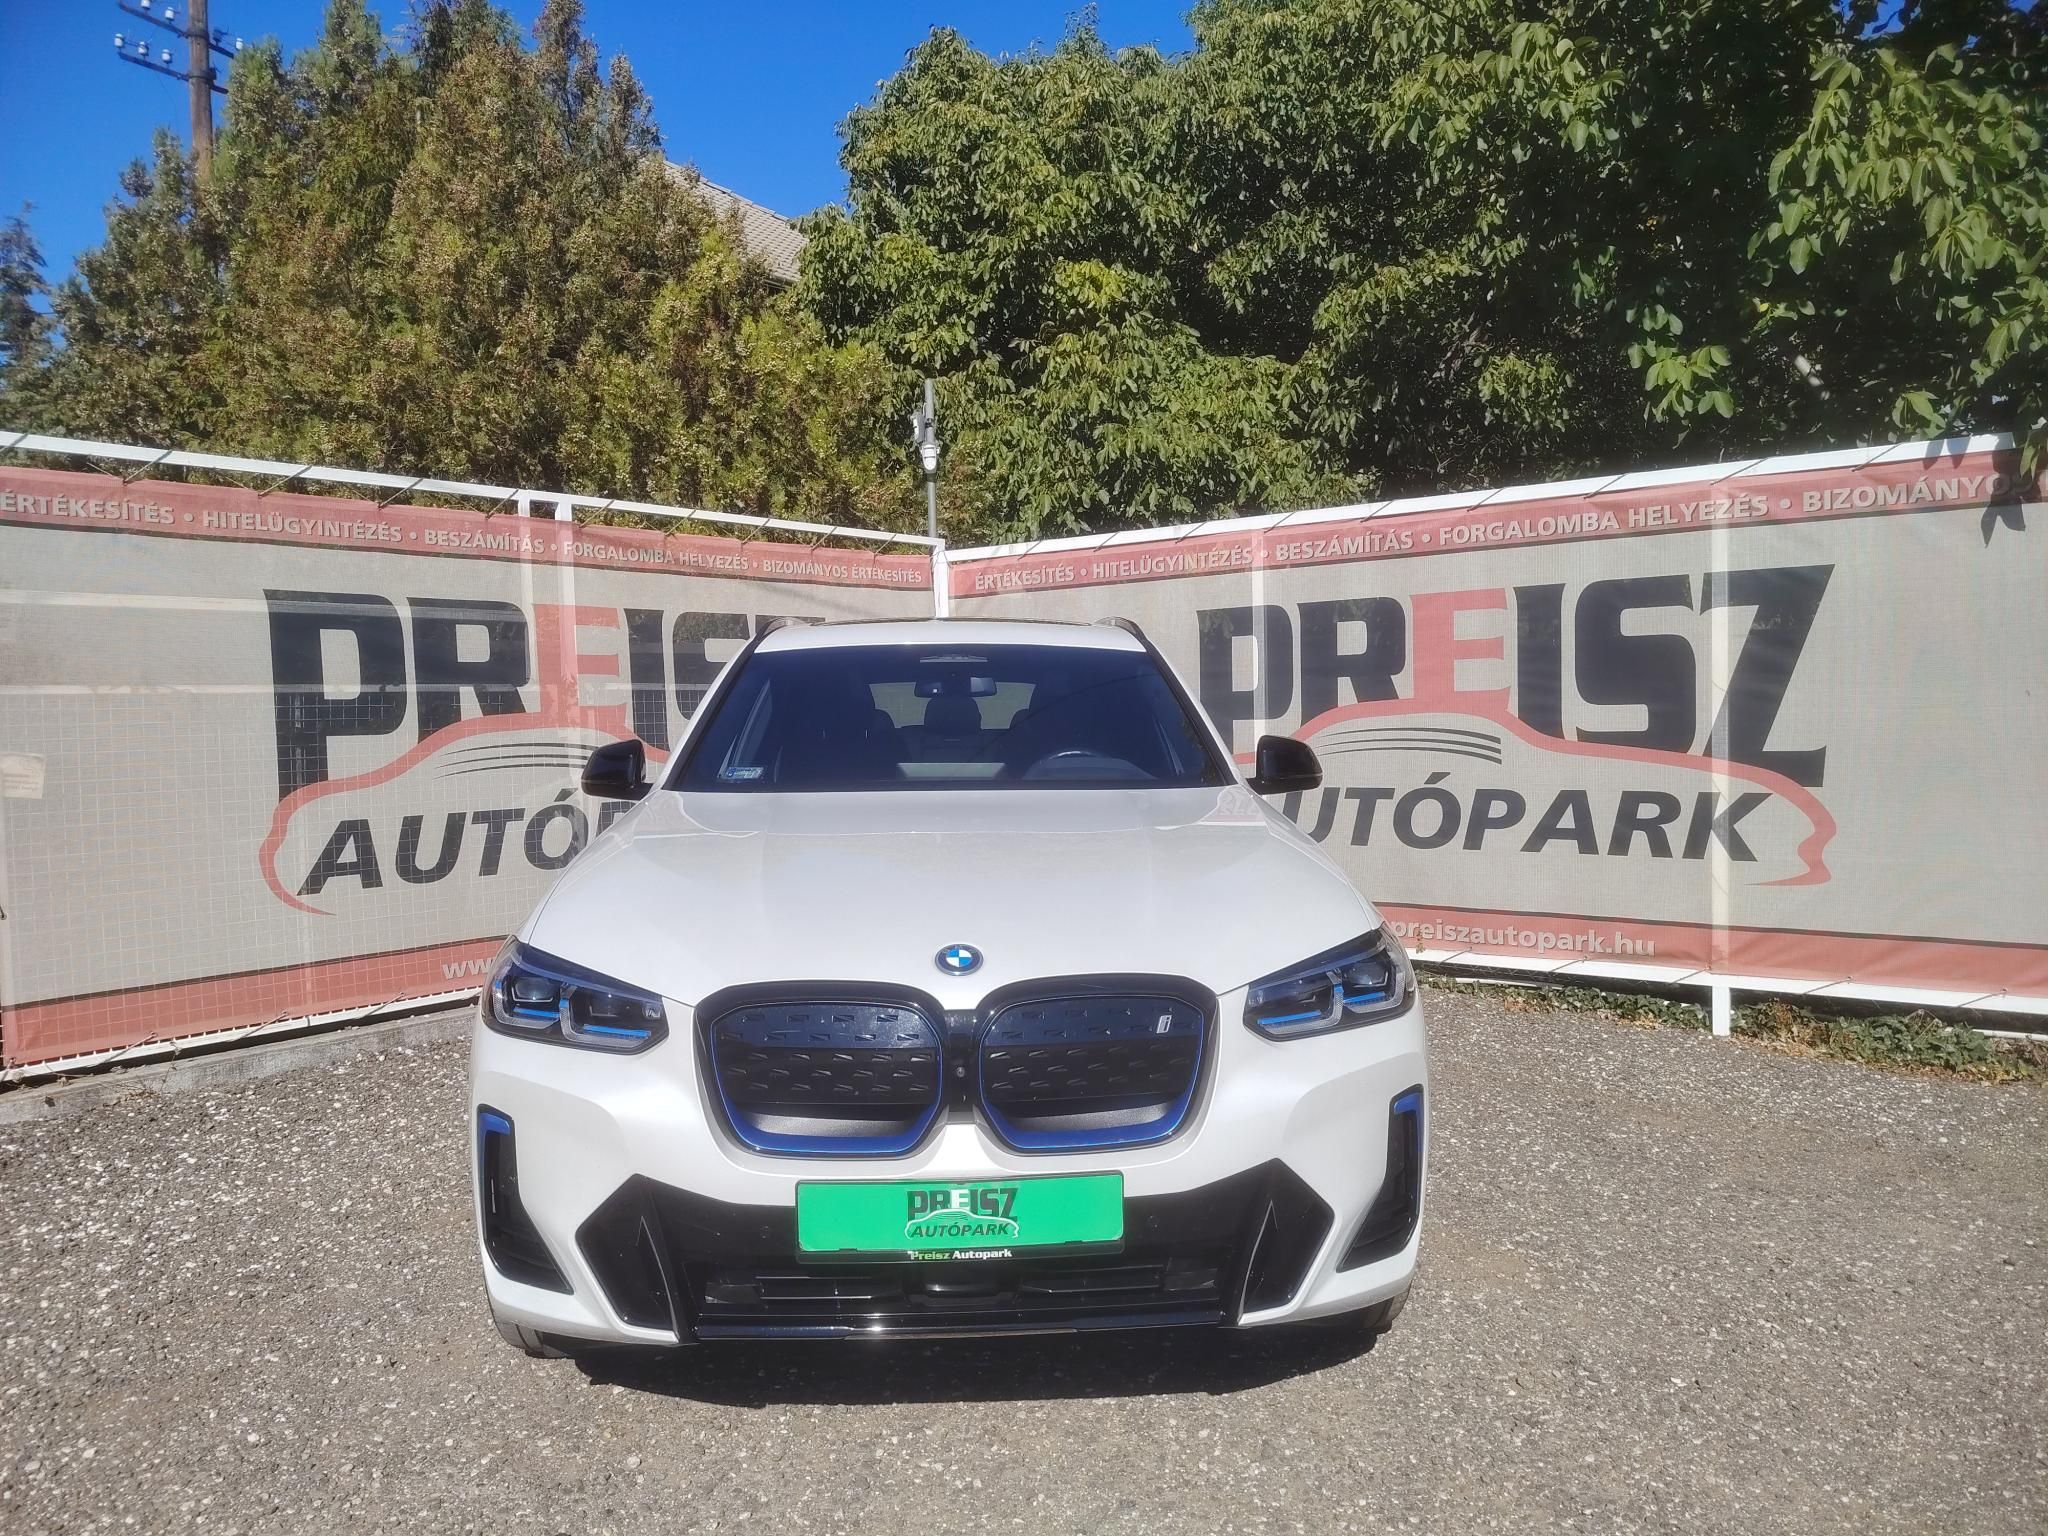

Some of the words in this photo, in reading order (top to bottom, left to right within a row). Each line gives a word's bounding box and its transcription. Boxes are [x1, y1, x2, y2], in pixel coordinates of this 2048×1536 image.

[0, 488, 174, 525] ÉRTÉKESÍTÉS
[203, 509, 403, 543] HITELÜGYINTÉZÉS
[424, 529, 545, 555] BESZÁMÍTÁS
[563, 541, 675, 566] FORGALOMBA
[679, 551, 749, 572] HELYEZÉS
[763, 558, 849, 580] BIZOMÁNYOS
[851, 563, 923, 584] ÉRTÉKESÍTÉS
[975, 563, 1075, 592] ÉRTÉKESÍTÉS
[1092, 544, 1254, 580] HITELÜGYINTÉZÉS
[1275, 527, 1414, 562] BESZÁMÍTÁS
[1439, 510, 1620, 546] FORGALOMBA
[1628, 493, 1768, 528] HELYEZÉS
[1196, 563, 1835, 788] PREISZ
[1283, 772, 1772, 862] UTÓPARK
[1390, 918, 1657, 956] preiszautopark.hu
[906, 1187, 1018, 1222] PREISZ
[910, 1221, 1011, 1238] AUTÓPARK
[907, 1250, 951, 1260] Preisz
[952, 1248, 1013, 1260] Autopark
